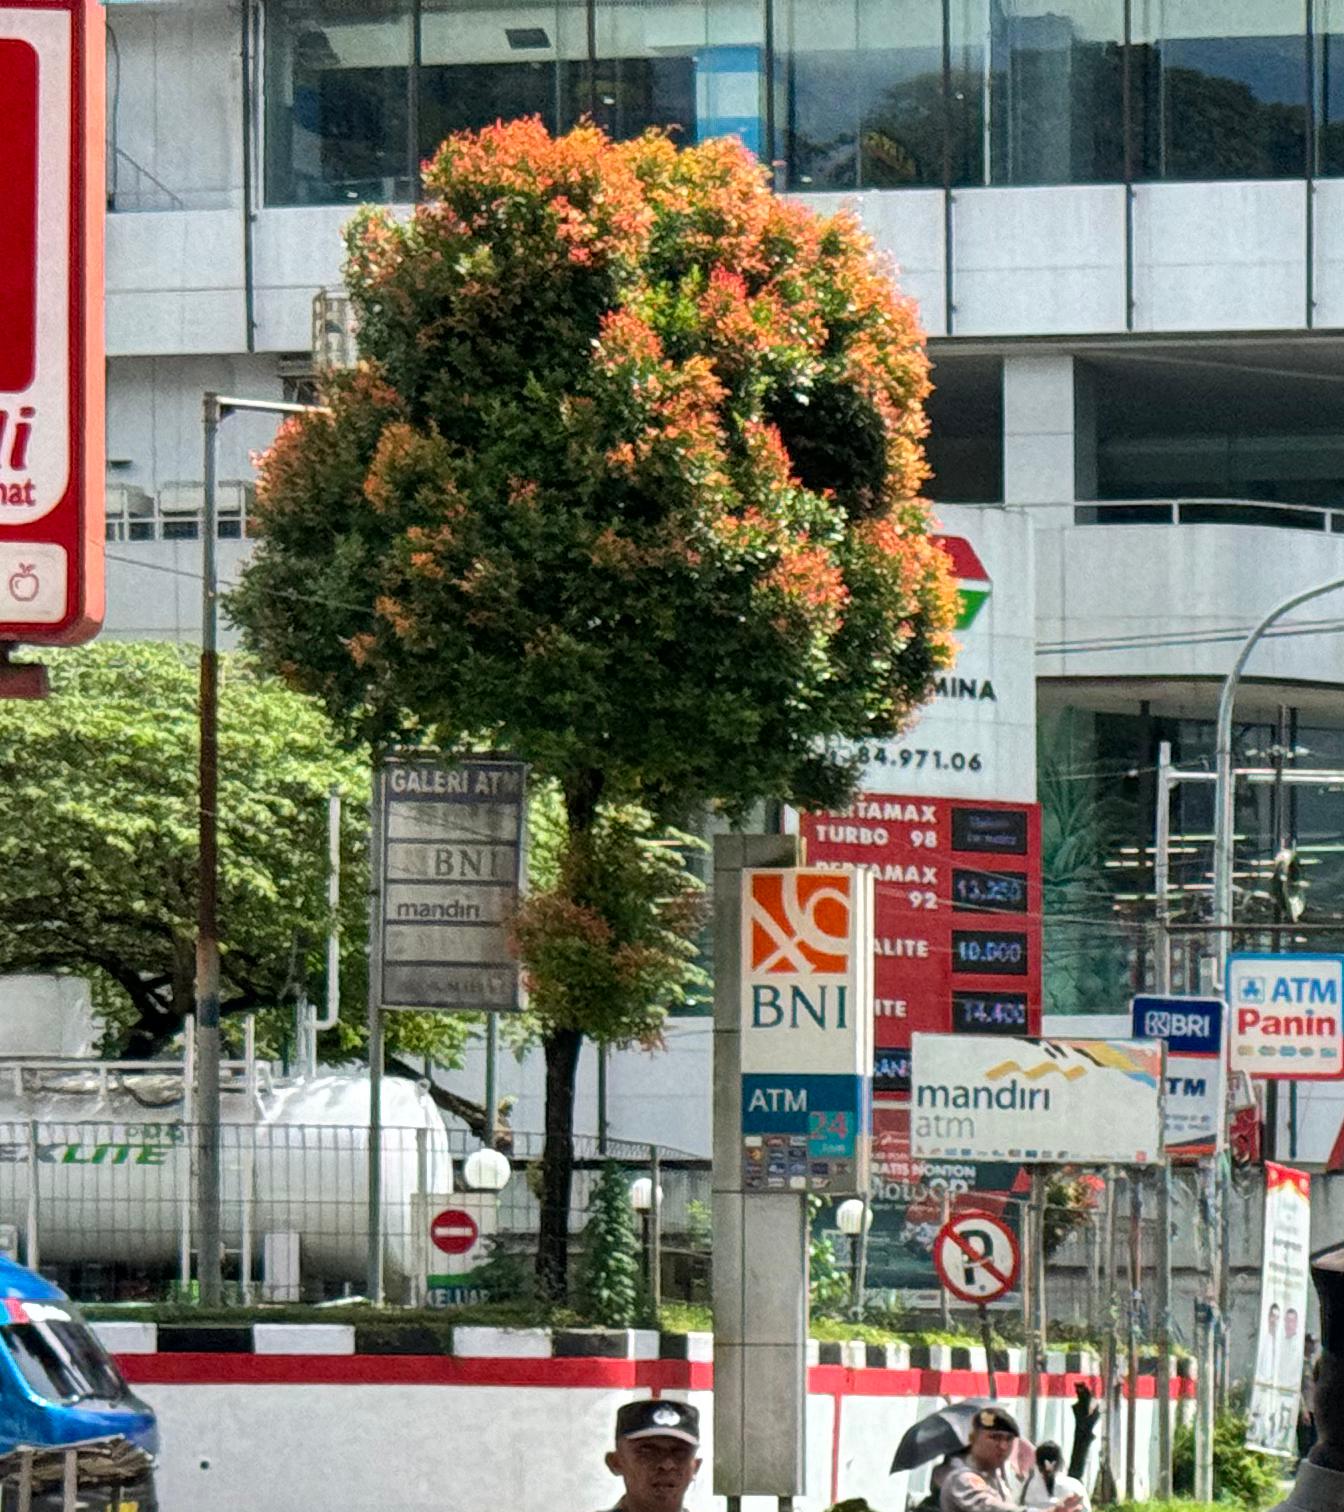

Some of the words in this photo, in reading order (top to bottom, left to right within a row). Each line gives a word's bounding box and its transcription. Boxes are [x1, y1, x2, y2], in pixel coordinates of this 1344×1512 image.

[857, 745, 983, 772] 84.971.06
[391, 769, 469, 794] GALERI
[815, 824, 889, 846] TURBO
[910, 830, 938, 849] 98
[434, 849, 498, 878] BNI
[908, 891, 938, 910] 92
[873, 938, 930, 958] ALITE
[1270, 976, 1338, 1005] ATM
[750, 984, 848, 1031] BNI
[1171, 1015, 1211, 1038] BRI
[1236, 1008, 1337, 1037] Panin
[748, 1088, 808, 1113] ATM
[915, 1079, 1051, 1111] mandiri
[1165, 1077, 1207, 1097] TM
[810, 1111, 848, 1140] 24
[914, 1111, 976, 1139] atm
